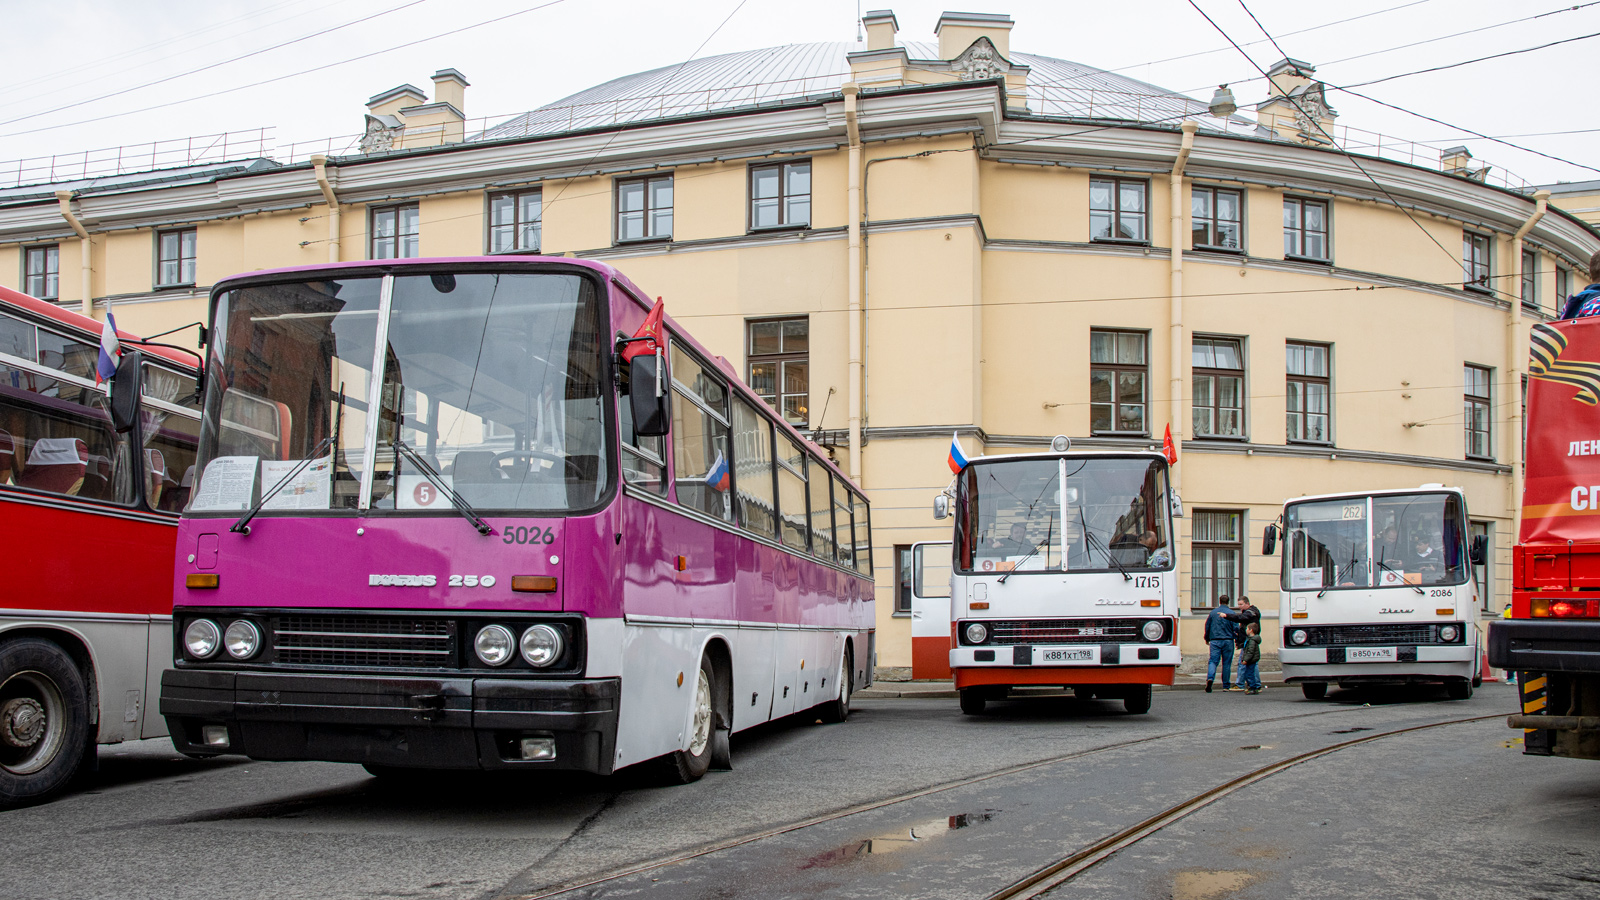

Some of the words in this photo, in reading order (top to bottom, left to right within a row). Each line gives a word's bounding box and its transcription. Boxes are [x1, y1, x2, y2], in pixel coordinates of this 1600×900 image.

[420, 486, 430, 503] 5
[1343, 506, 1361, 519] 262
[502, 526, 555, 545] 5026
[368, 574, 437, 588] IKARUS
[448, 575, 496, 588] 250
[1134, 576, 1160, 588] 1715
[1430, 589, 1453, 597] 2086
